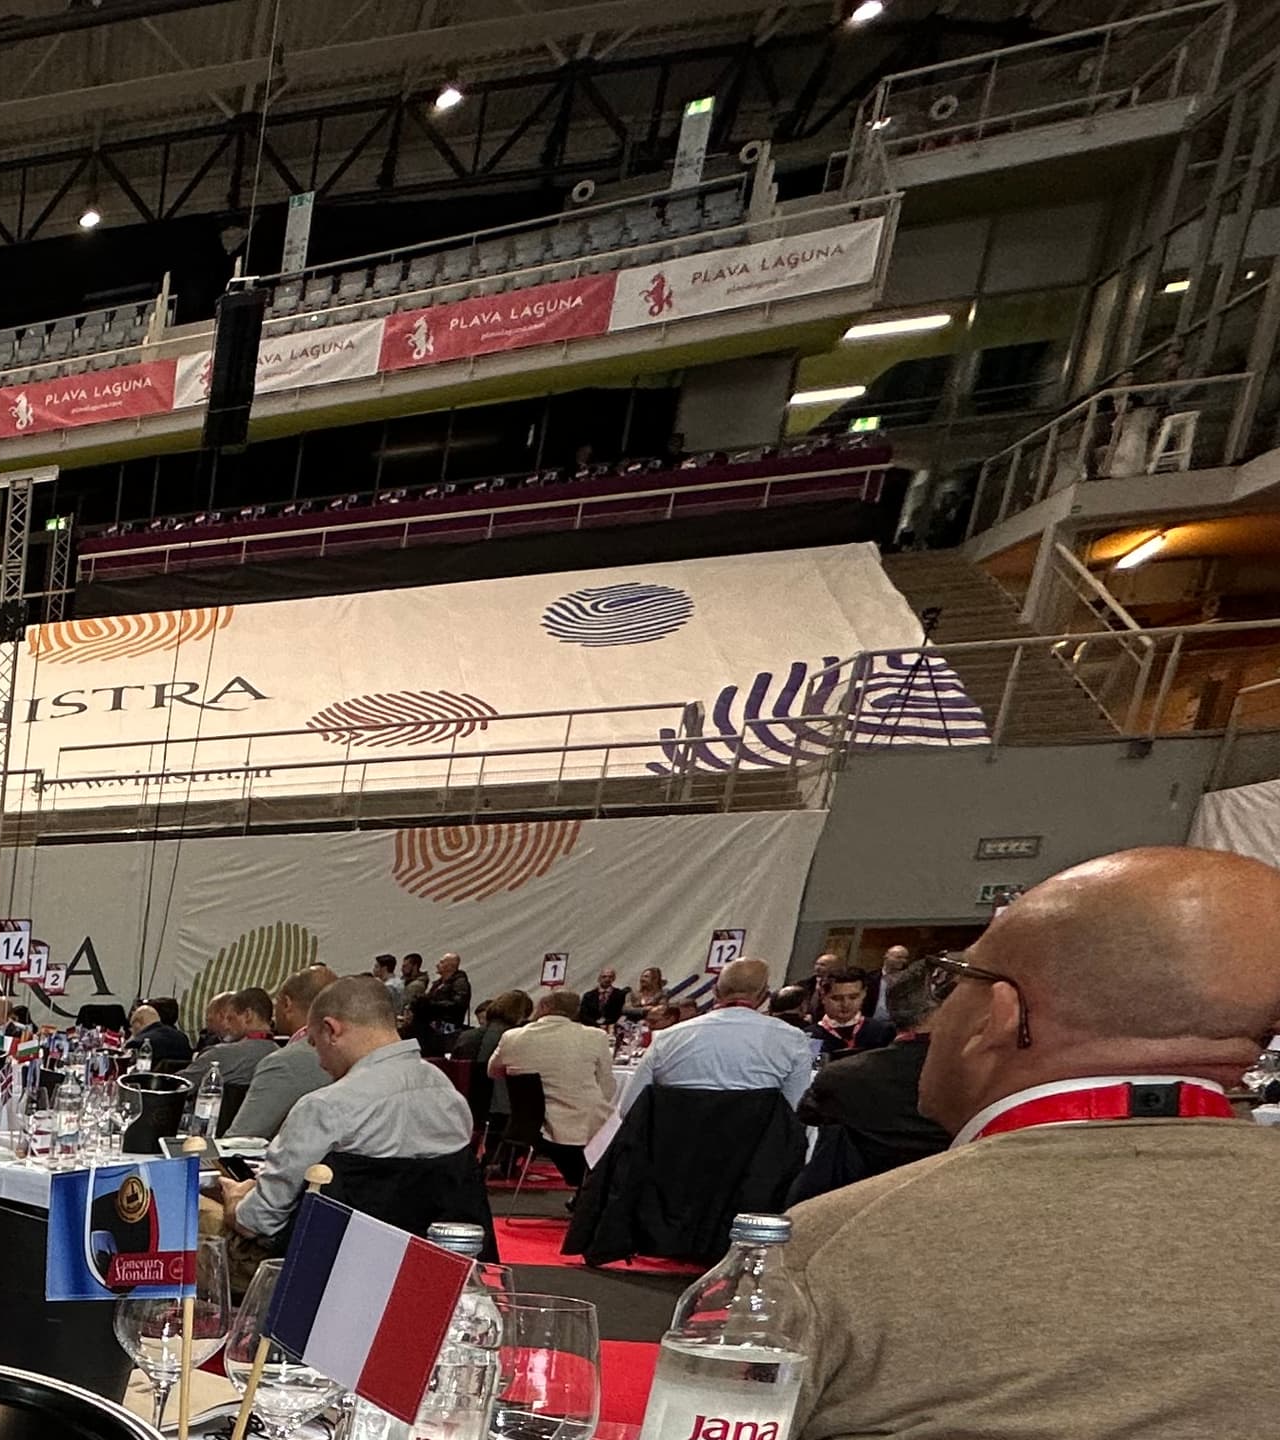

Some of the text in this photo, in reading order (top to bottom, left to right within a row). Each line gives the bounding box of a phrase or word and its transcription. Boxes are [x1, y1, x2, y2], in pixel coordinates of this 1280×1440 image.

[690, 262, 751, 286] PLAVA
[759, 243, 845, 276] LAGUNA
[448, 294, 585, 331] PLAVA LAGUNA
[254, 337, 356, 367] AVA LAGUNA
[44, 376, 153, 407] PLAVA LAGUNA
[2, 937, 25, 960] 14
[716, 944, 738, 964] 12
[50, 973, 60, 987] 2
[550, 964, 558, 978] 1
[115, 1257, 165, 1270] Concours
[115, 1265, 165, 1281] Mondial
